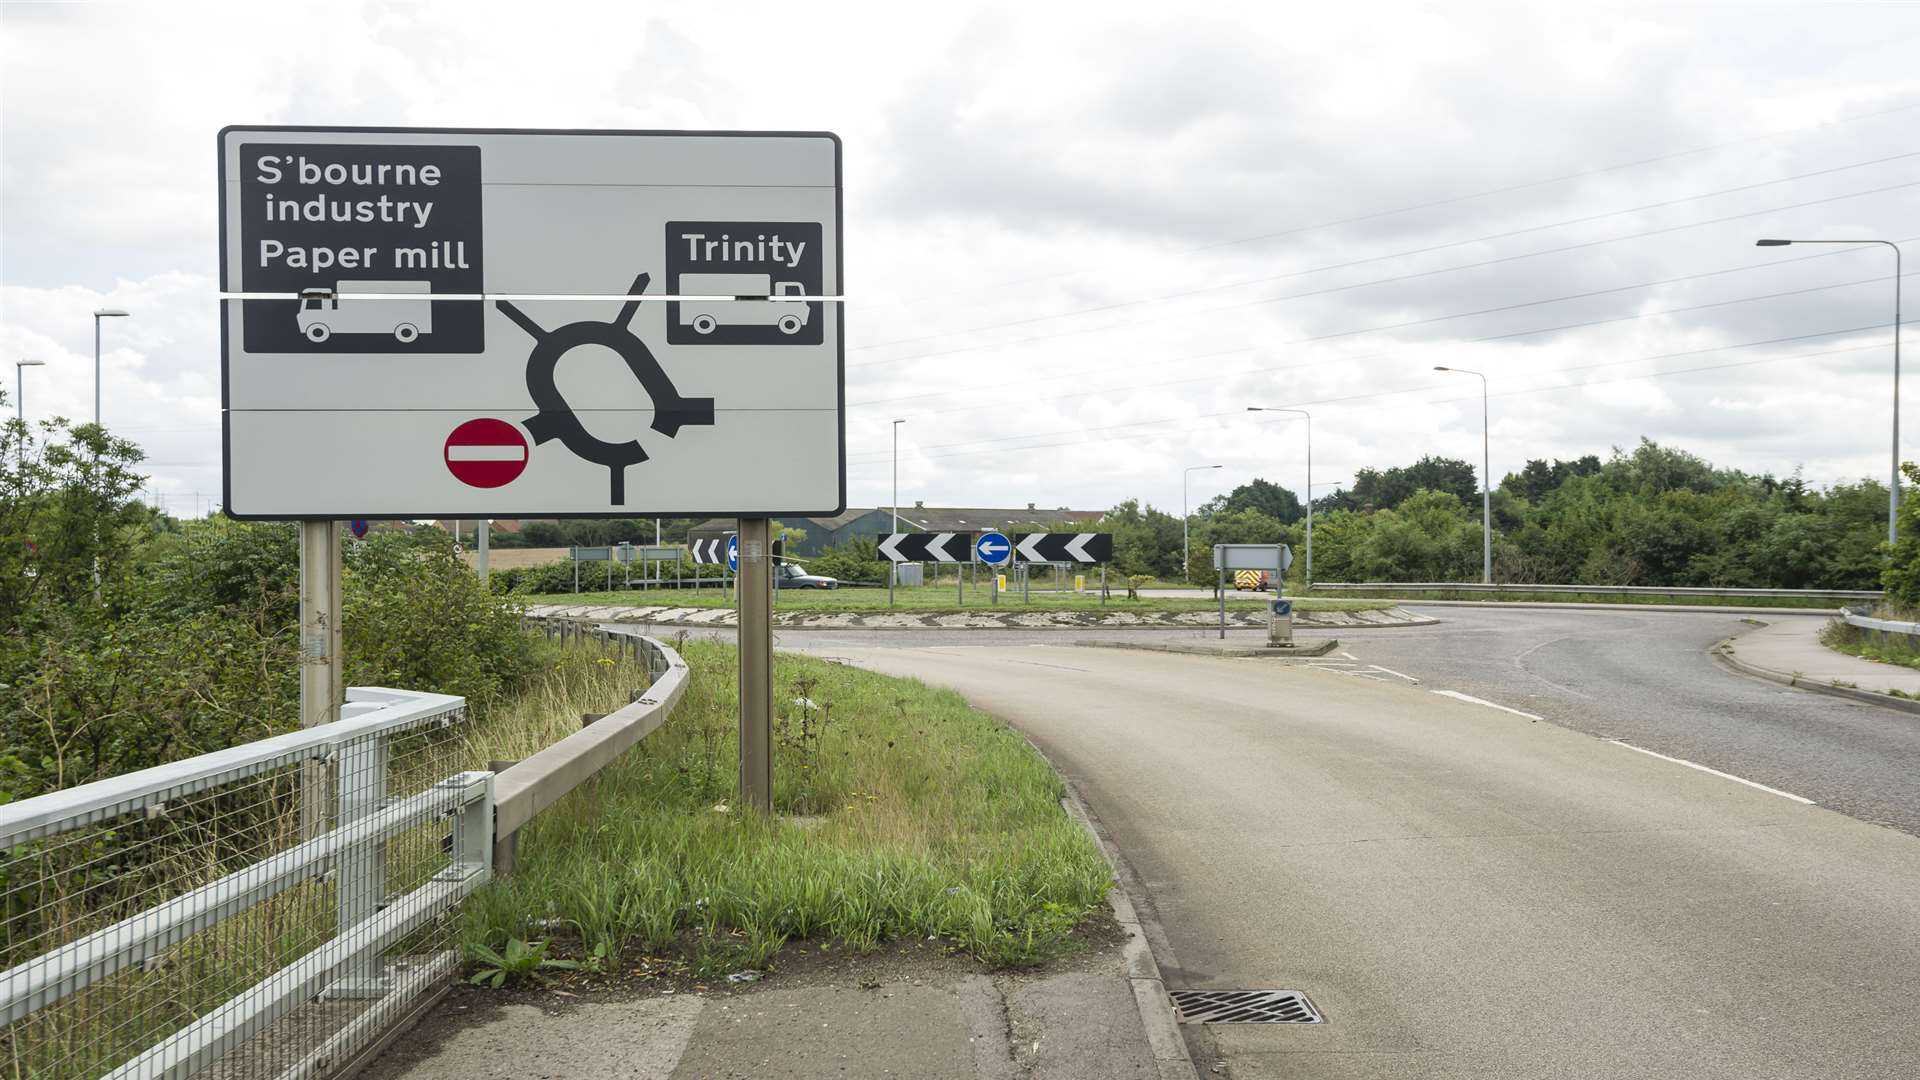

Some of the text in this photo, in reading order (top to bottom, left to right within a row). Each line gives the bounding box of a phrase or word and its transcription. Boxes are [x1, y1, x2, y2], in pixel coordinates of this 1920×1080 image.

[256, 155, 441, 186] S'bourne
[266, 193, 434, 229] industry
[260, 239, 469, 274] Paper mill
[681, 233, 806, 268] Trinity
